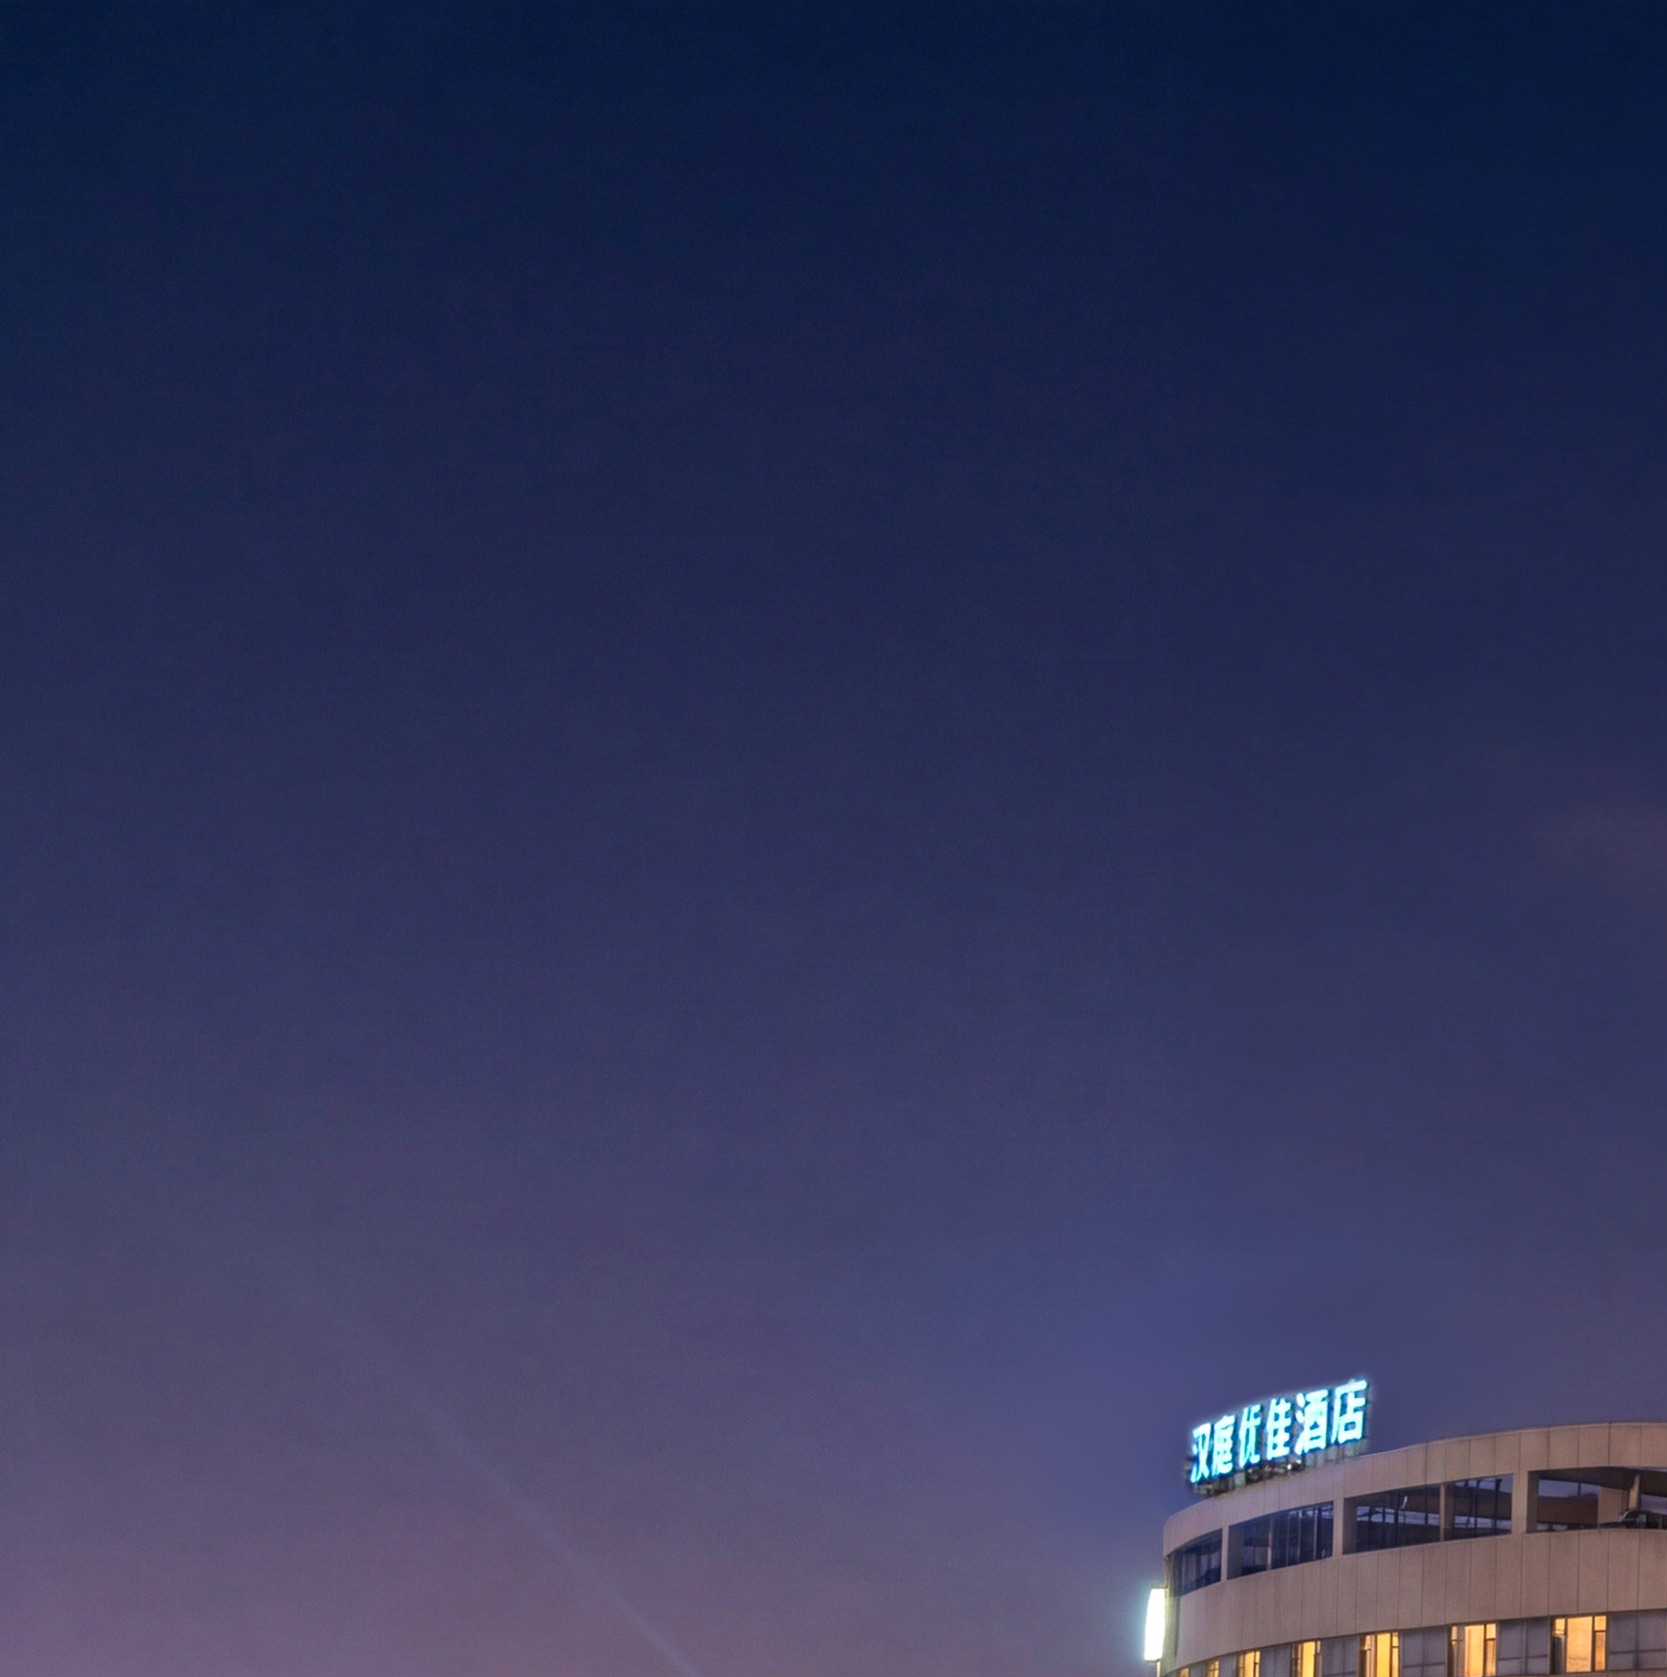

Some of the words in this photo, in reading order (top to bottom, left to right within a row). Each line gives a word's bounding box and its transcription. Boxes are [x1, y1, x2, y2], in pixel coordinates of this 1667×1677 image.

[1190, 1379, 1367, 1482] 汉庭优佳酒店
